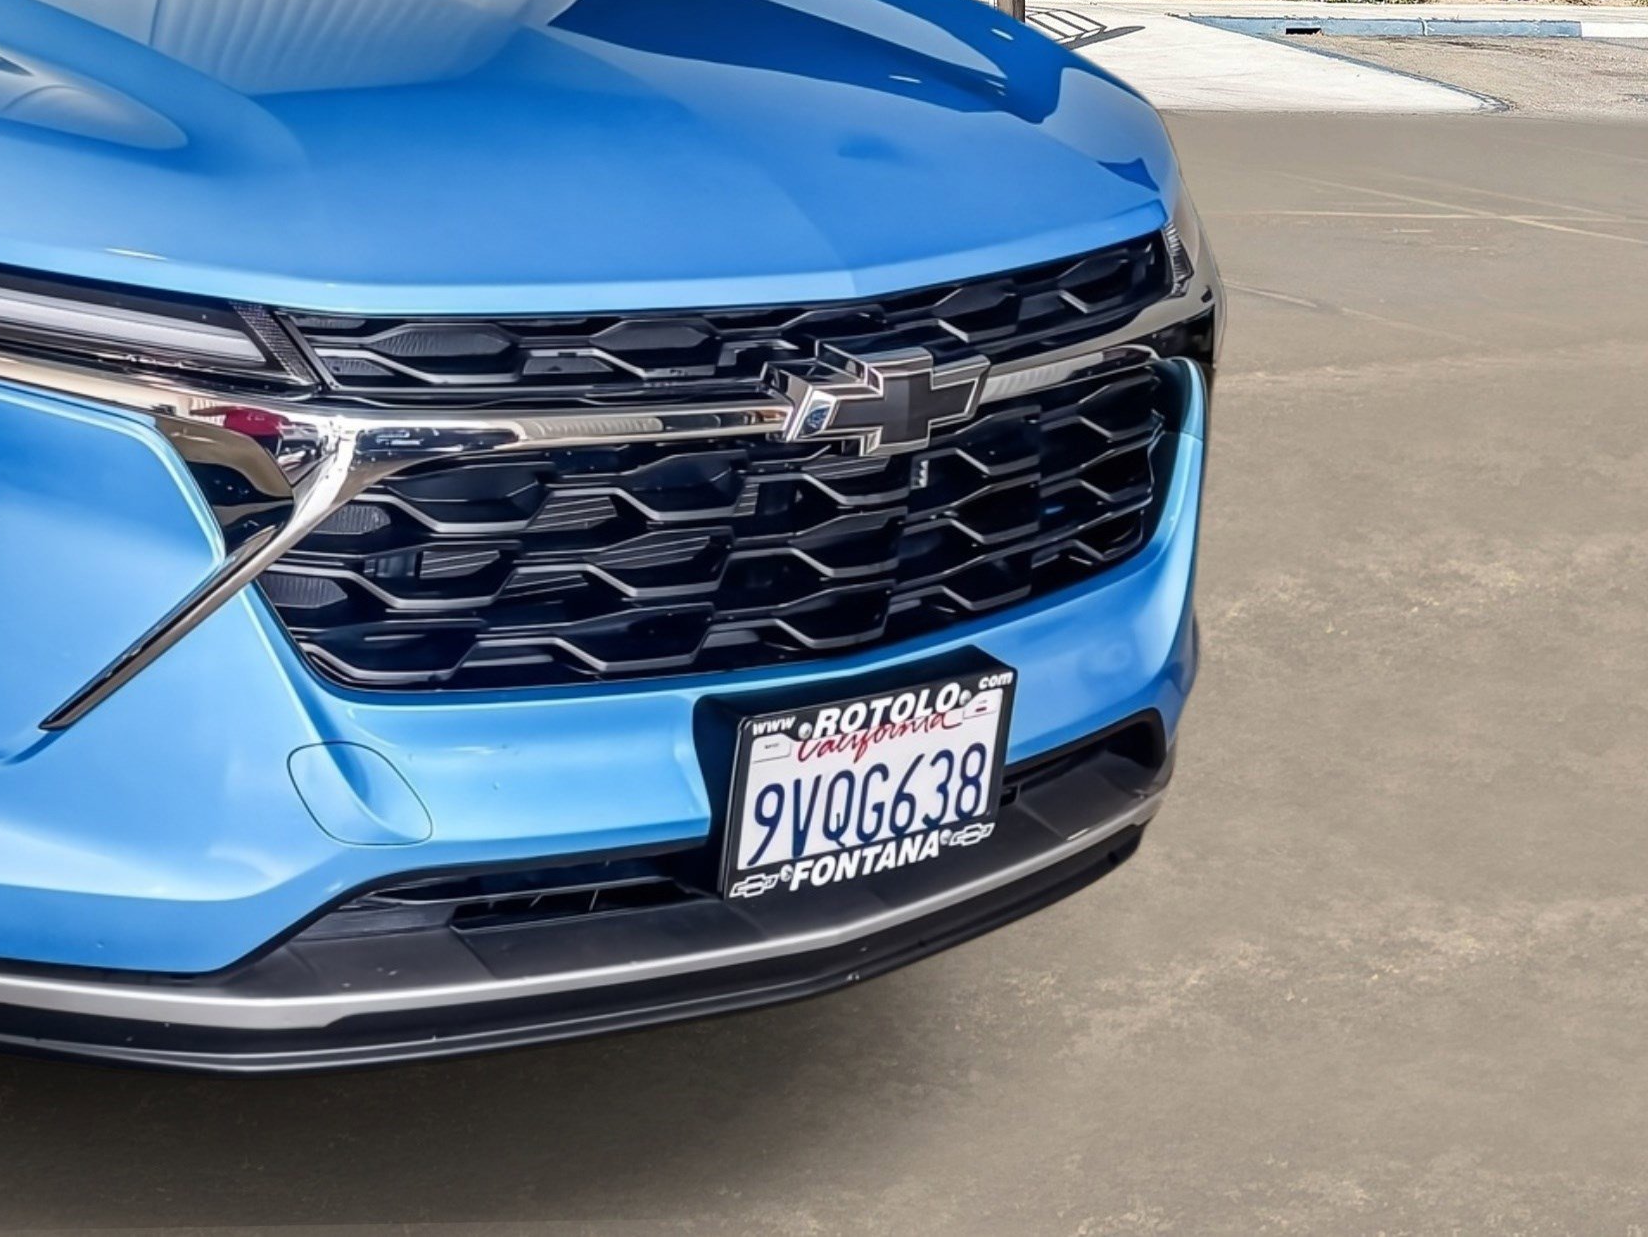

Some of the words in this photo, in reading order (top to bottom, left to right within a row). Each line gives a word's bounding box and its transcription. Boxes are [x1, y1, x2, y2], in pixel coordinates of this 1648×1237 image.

[812, 682, 960, 739] ROTOLO
[747, 743, 987, 866] 9VQG638
[789, 829, 940, 892] FONTANA
